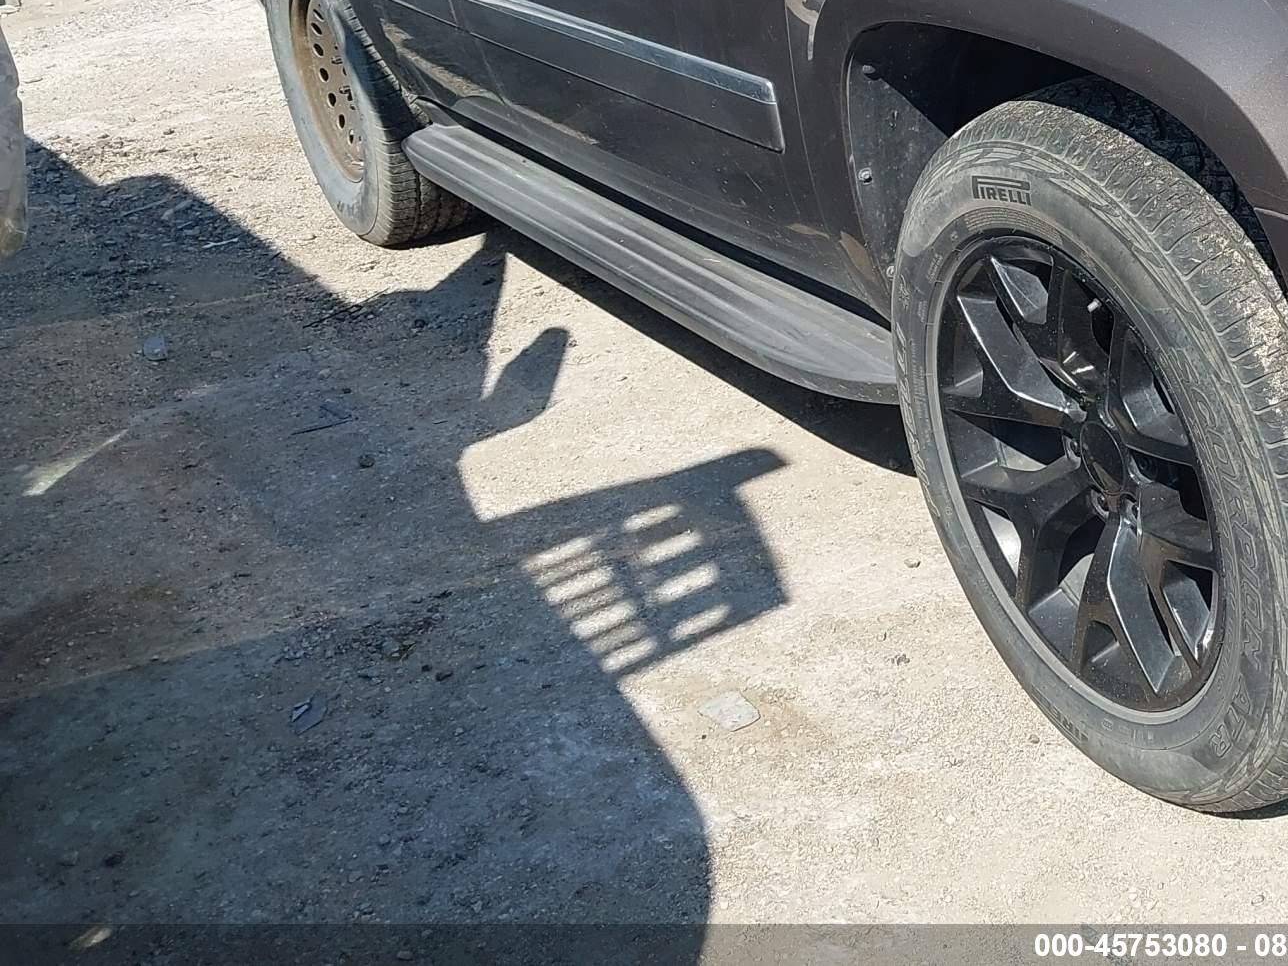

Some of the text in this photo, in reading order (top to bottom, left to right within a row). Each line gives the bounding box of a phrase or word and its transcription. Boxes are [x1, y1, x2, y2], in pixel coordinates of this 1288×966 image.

[972, 175, 1032, 207] PIRELLI
[1166, 346, 1265, 671] SCORPION
[1208, 671, 1252, 758] ATR
